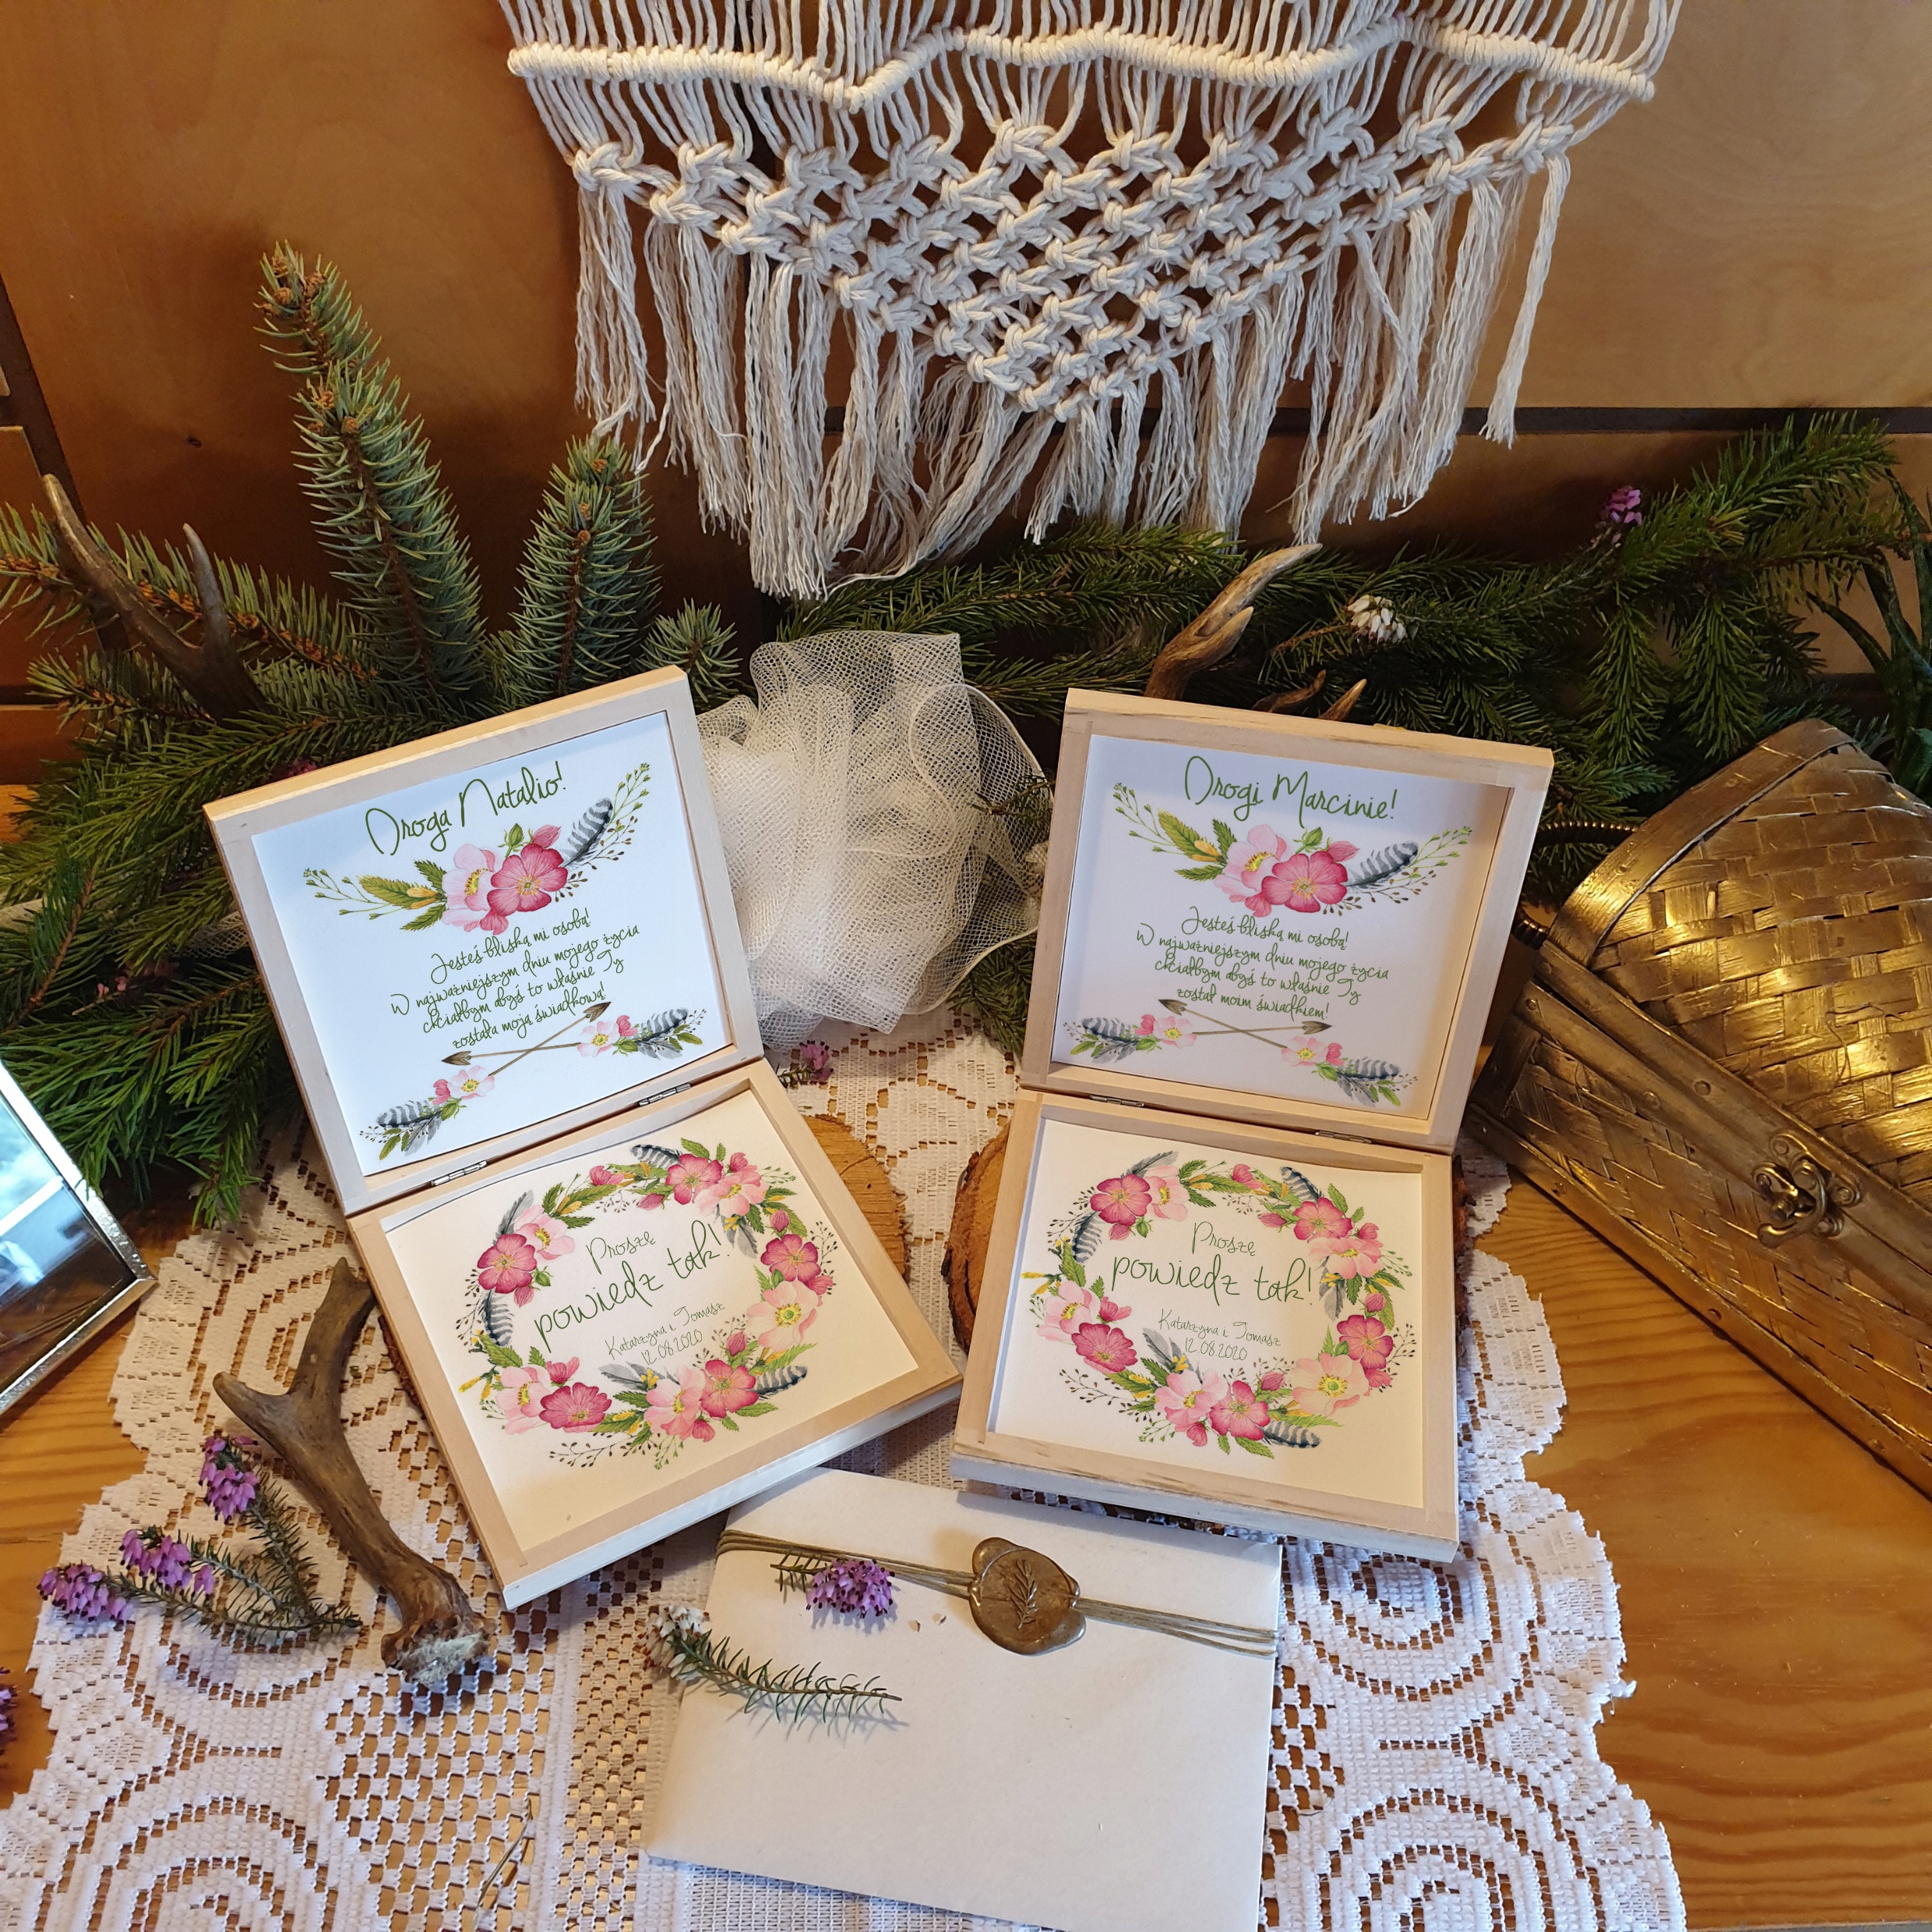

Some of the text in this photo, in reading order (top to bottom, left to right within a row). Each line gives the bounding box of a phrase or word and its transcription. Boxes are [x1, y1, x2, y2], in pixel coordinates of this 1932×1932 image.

[365, 760, 566, 855] Droga Natalio!
[1185, 756, 1398, 828] Drogi Marcinie!
[1181, 906, 1235, 935] Jesteś
[1237, 915, 1285, 941] bliską
[1288, 930, 1303, 943] mi
[391, 993, 410, 1015] W
[523, 950, 552, 977] dniu
[554, 939, 599, 968] mojego
[602, 925, 640, 948] życia
[431, 945, 483, 984] Jesteś
[483, 926, 531, 956] bliską
[533, 928, 550, 942] mi
[1137, 922, 1155, 946] W
[1265, 943, 1294, 971] dniu
[1299, 957, 1347, 982] mojego
[1350, 964, 1389, 981] życia
[495, 985, 525, 1011] abyś
[528, 985, 543, 997] to
[548, 966, 595, 986] właśnie
[1225, 963, 1257, 989] abyś
[1260, 972, 1277, 987] to
[1280, 971, 1330, 995] właśnie
[1176, 983, 1330, 1021] został moim świadkiem!
[453, 1019, 498, 1049] została
[502, 1014, 534, 1038] moją
[534, 1220, 730, 1353] powiedz tak!
[1111, 1253, 1313, 1306] powiedz tak!
[605, 1325, 667, 1360] Katarzyna
[668, 1321, 676, 1332] i
[1158, 1308, 1218, 1339] Katarzyna
[1222, 1327, 1229, 1338] i
[641, 1329, 703, 1365] 12.08.2020
[1185, 1337, 1247, 1361] 12.08.2020
